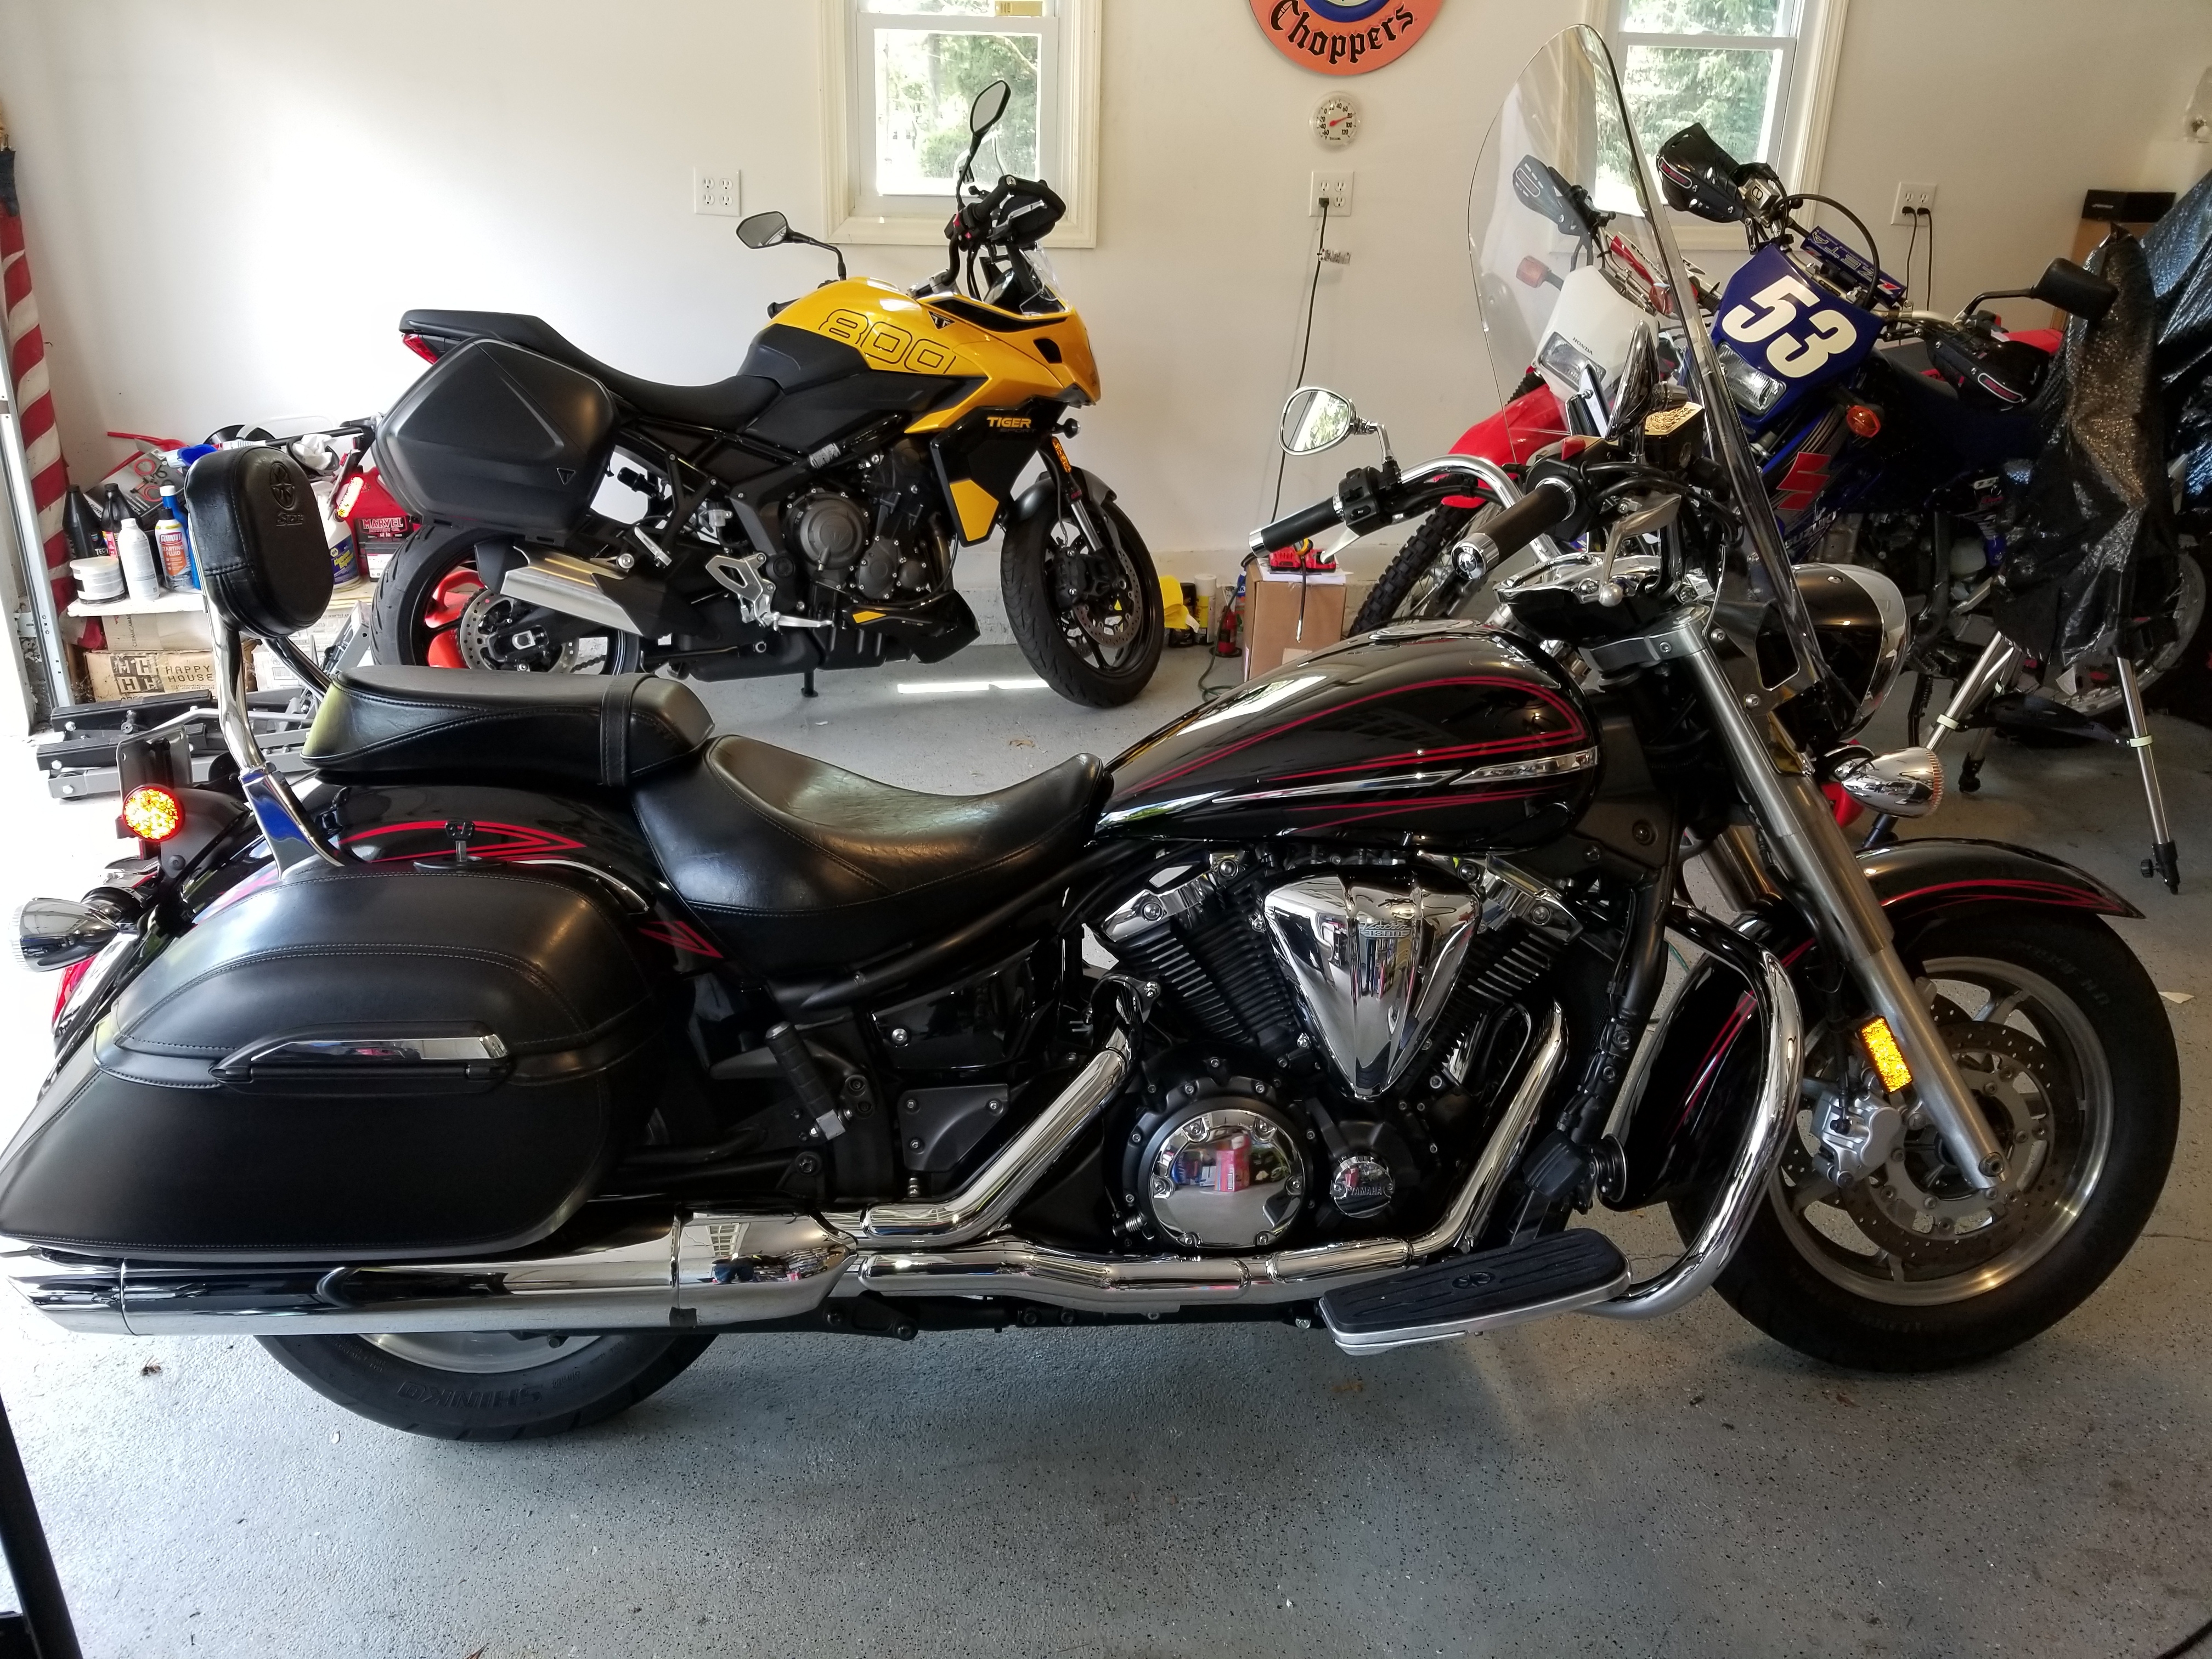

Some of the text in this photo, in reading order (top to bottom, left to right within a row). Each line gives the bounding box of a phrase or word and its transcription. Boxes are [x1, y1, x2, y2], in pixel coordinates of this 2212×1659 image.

[1271, 0, 1414, 64] Choppers
[1721, 275, 1857, 379] 53
[818, 309, 956, 375] 800
[1572, 337, 1593, 356] HONDA
[986, 416, 1032, 428] TIGER
[362, 517, 404, 529] MARVEL
[165, 665, 210, 674] HAPPY
[168, 673, 214, 682] HOUSE
[1351, 1187, 1383, 1195] YAMAHA
[397, 1380, 543, 1410] SHINKO
